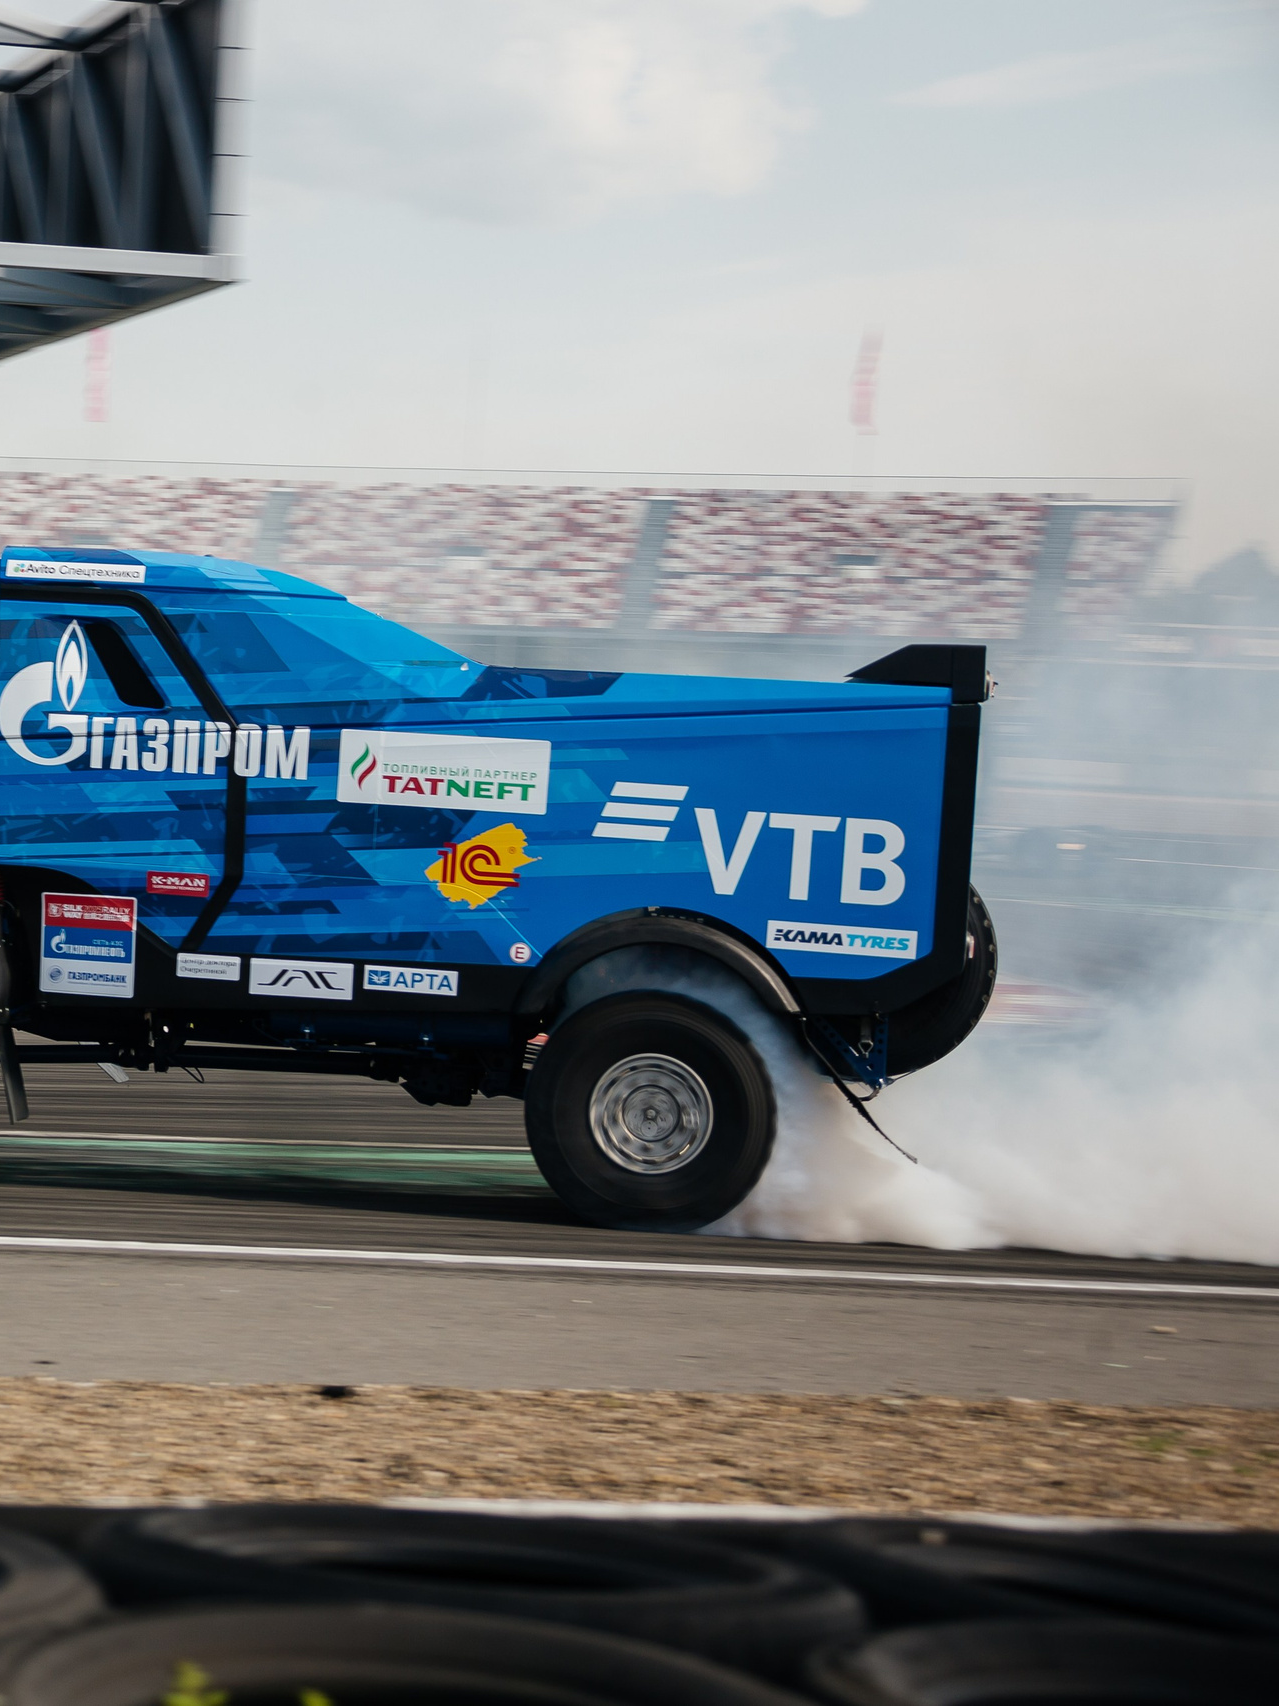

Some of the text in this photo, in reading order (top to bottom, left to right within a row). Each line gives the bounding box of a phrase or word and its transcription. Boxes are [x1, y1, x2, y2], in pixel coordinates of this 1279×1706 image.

[27, 564, 140, 579] Avito Спецтехника
[89, 716, 311, 781] ГАЗПРОМ
[383, 762, 538, 781] ТОПЛИВНЫЙ ПАРТНЕР
[382, 775, 536, 801] TATNEFT
[694, 807, 906, 906] VTB
[151, 875, 206, 887] K-MAN
[774, 928, 910, 951] KAMA TYRES
[67, 970, 127, 984] ГАЗПРОМБАНК
